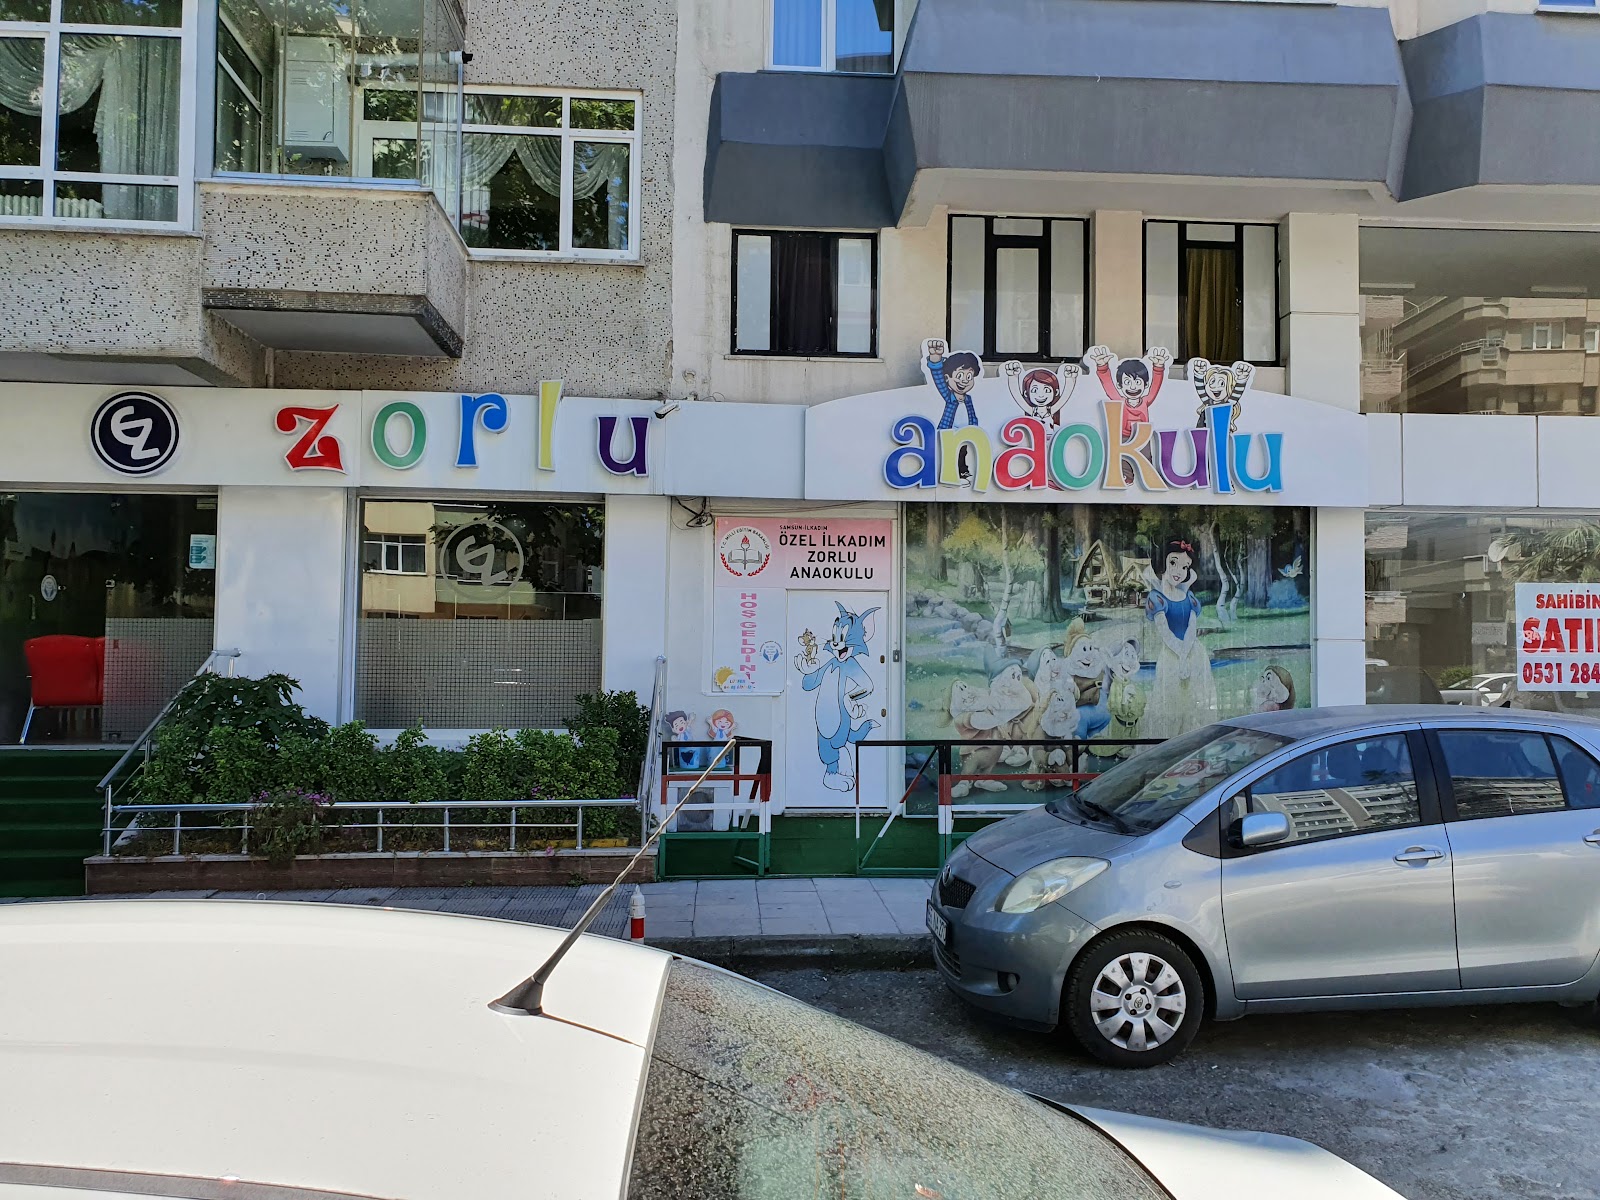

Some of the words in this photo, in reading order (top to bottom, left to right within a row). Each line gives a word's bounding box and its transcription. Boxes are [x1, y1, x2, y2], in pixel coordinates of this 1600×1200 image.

[274, 379, 651, 477] zorlu
[883, 399, 1284, 494] anaokulu
[779, 531, 817, 546] ÖZEL
[822, 532, 886, 547] İLKADIM
[807, 550, 857, 563] ZORLU
[790, 566, 874, 579] ANAOKULU
[1522, 617, 1600, 654] SATI
[1522, 662, 1563, 684] 0531
[1570, 662, 1600, 684] 284
